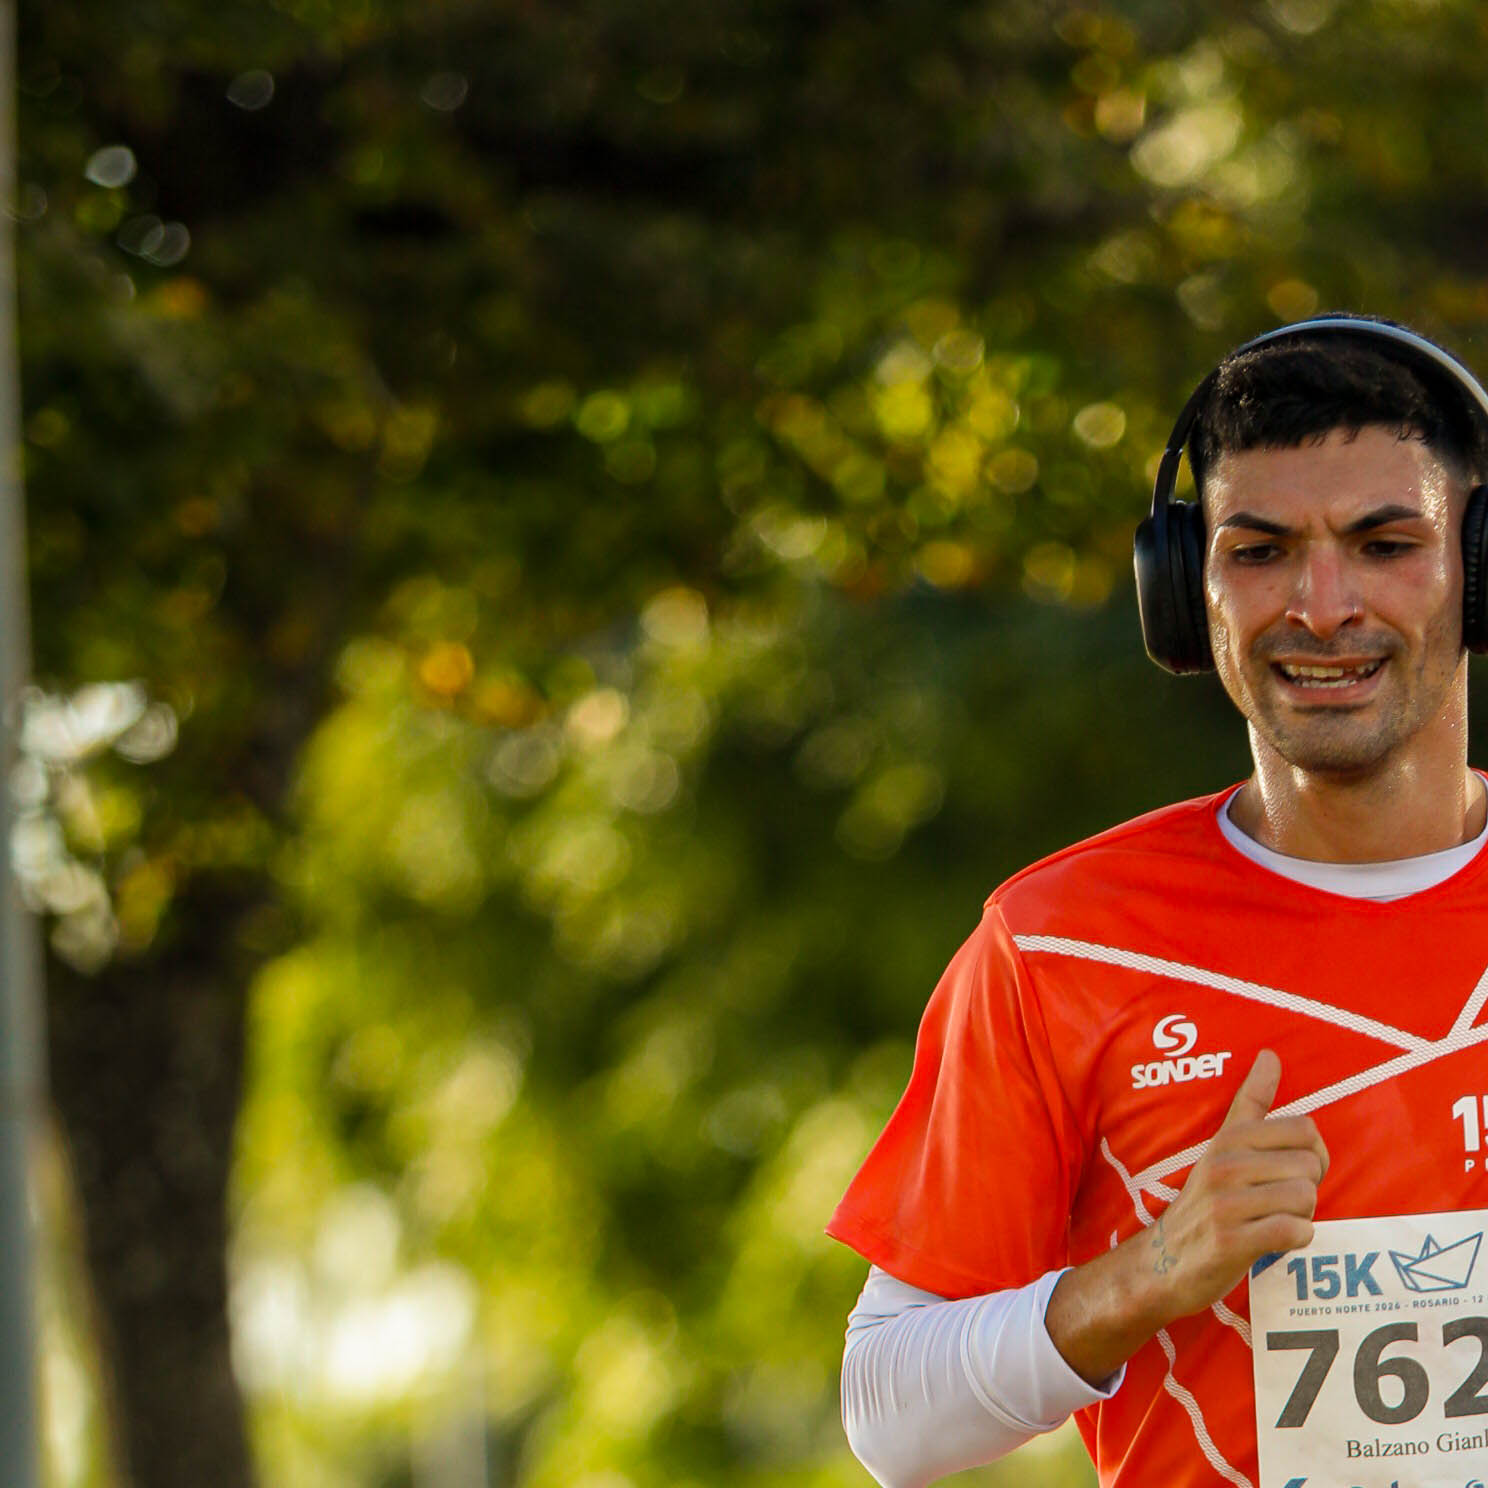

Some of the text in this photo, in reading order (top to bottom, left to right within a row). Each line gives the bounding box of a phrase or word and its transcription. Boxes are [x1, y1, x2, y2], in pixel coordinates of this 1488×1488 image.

[1287, 1251, 1384, 1301] 15K
[1289, 1306, 1332, 1317] PUERTO
[1335, 1303, 1371, 1314] NORTE
[1375, 1301, 1401, 1312] 2026
[1412, 1297, 1460, 1309] ROSARIO
[1472, 1295, 1484, 1304] 12
[1346, 1438, 1430, 1459] Balzano
